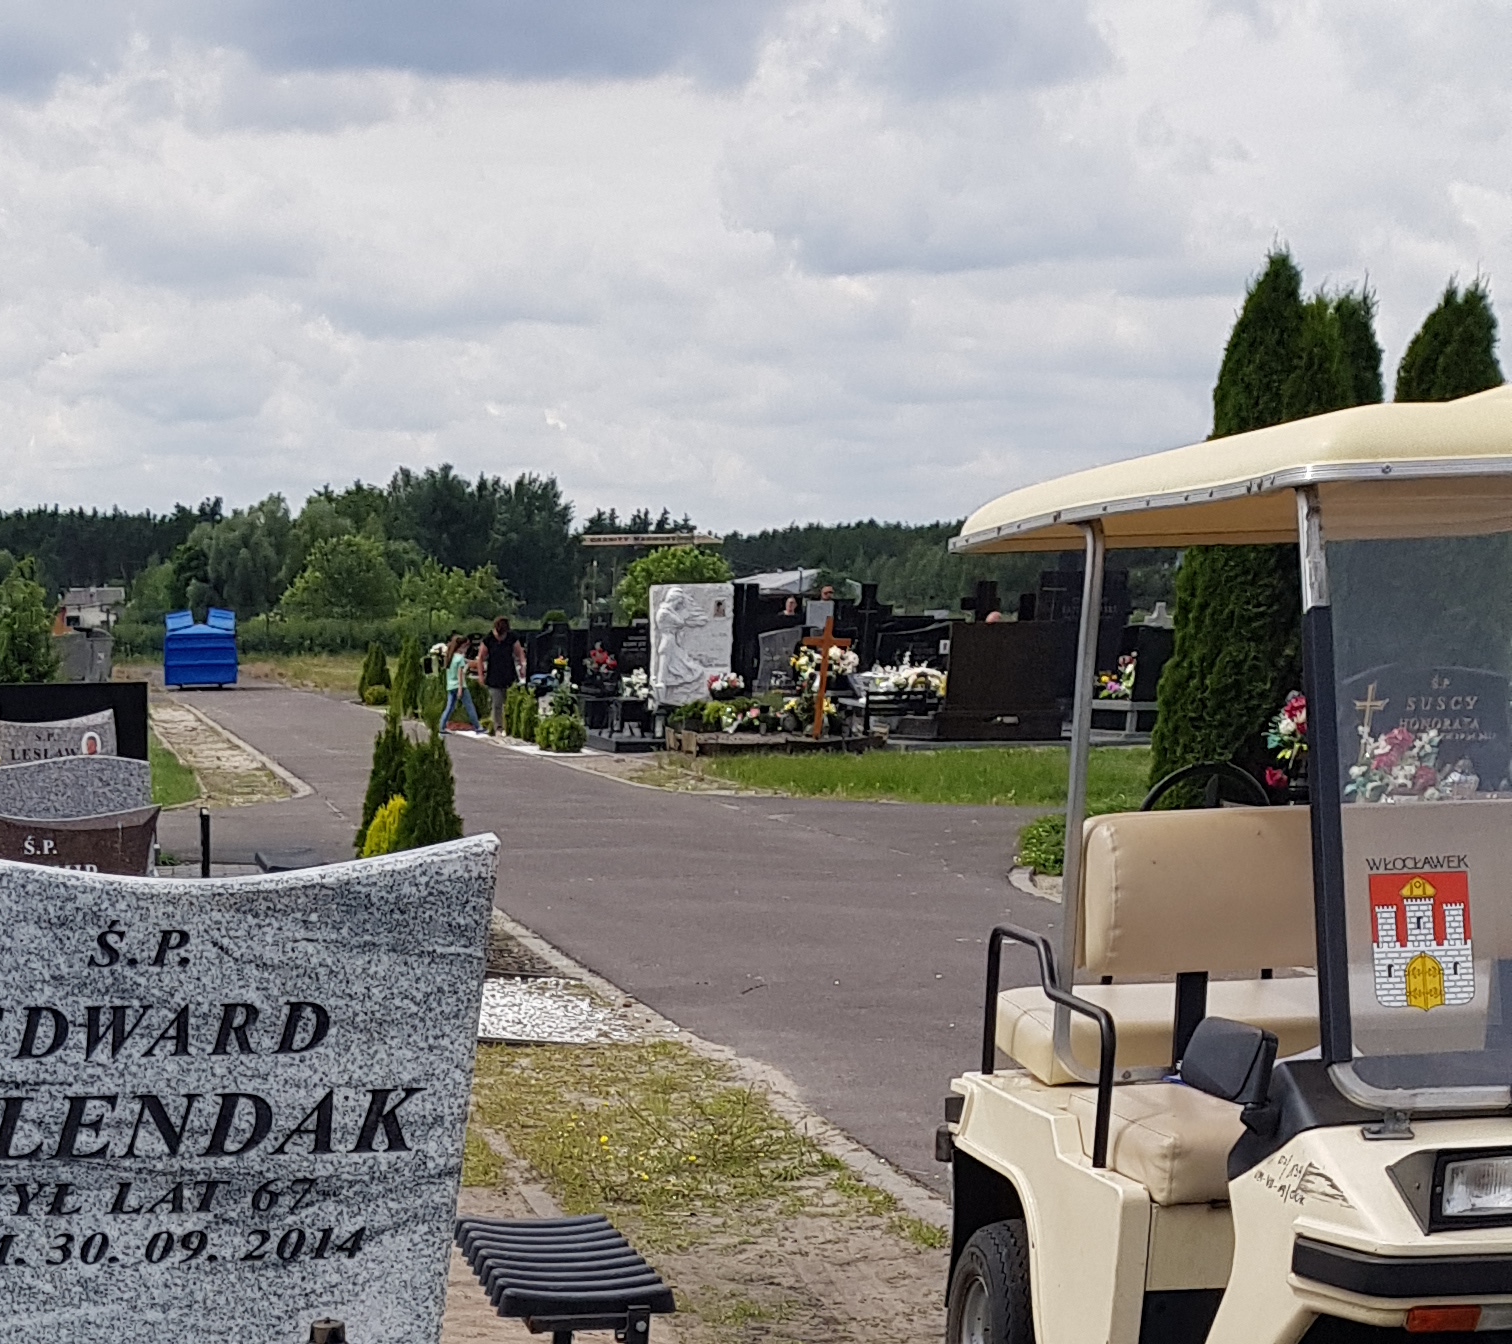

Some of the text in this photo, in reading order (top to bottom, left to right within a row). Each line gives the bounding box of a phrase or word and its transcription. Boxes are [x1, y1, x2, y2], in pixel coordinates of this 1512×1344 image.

[23, 834, 58, 855] Ś.P.
[1366, 854, 1469, 871] WŁOCŁAWEK
[87, 919, 191, 968] Ś.P.
[105, 1181, 231, 1215] LAT
[251, 1178, 318, 1213] 67
